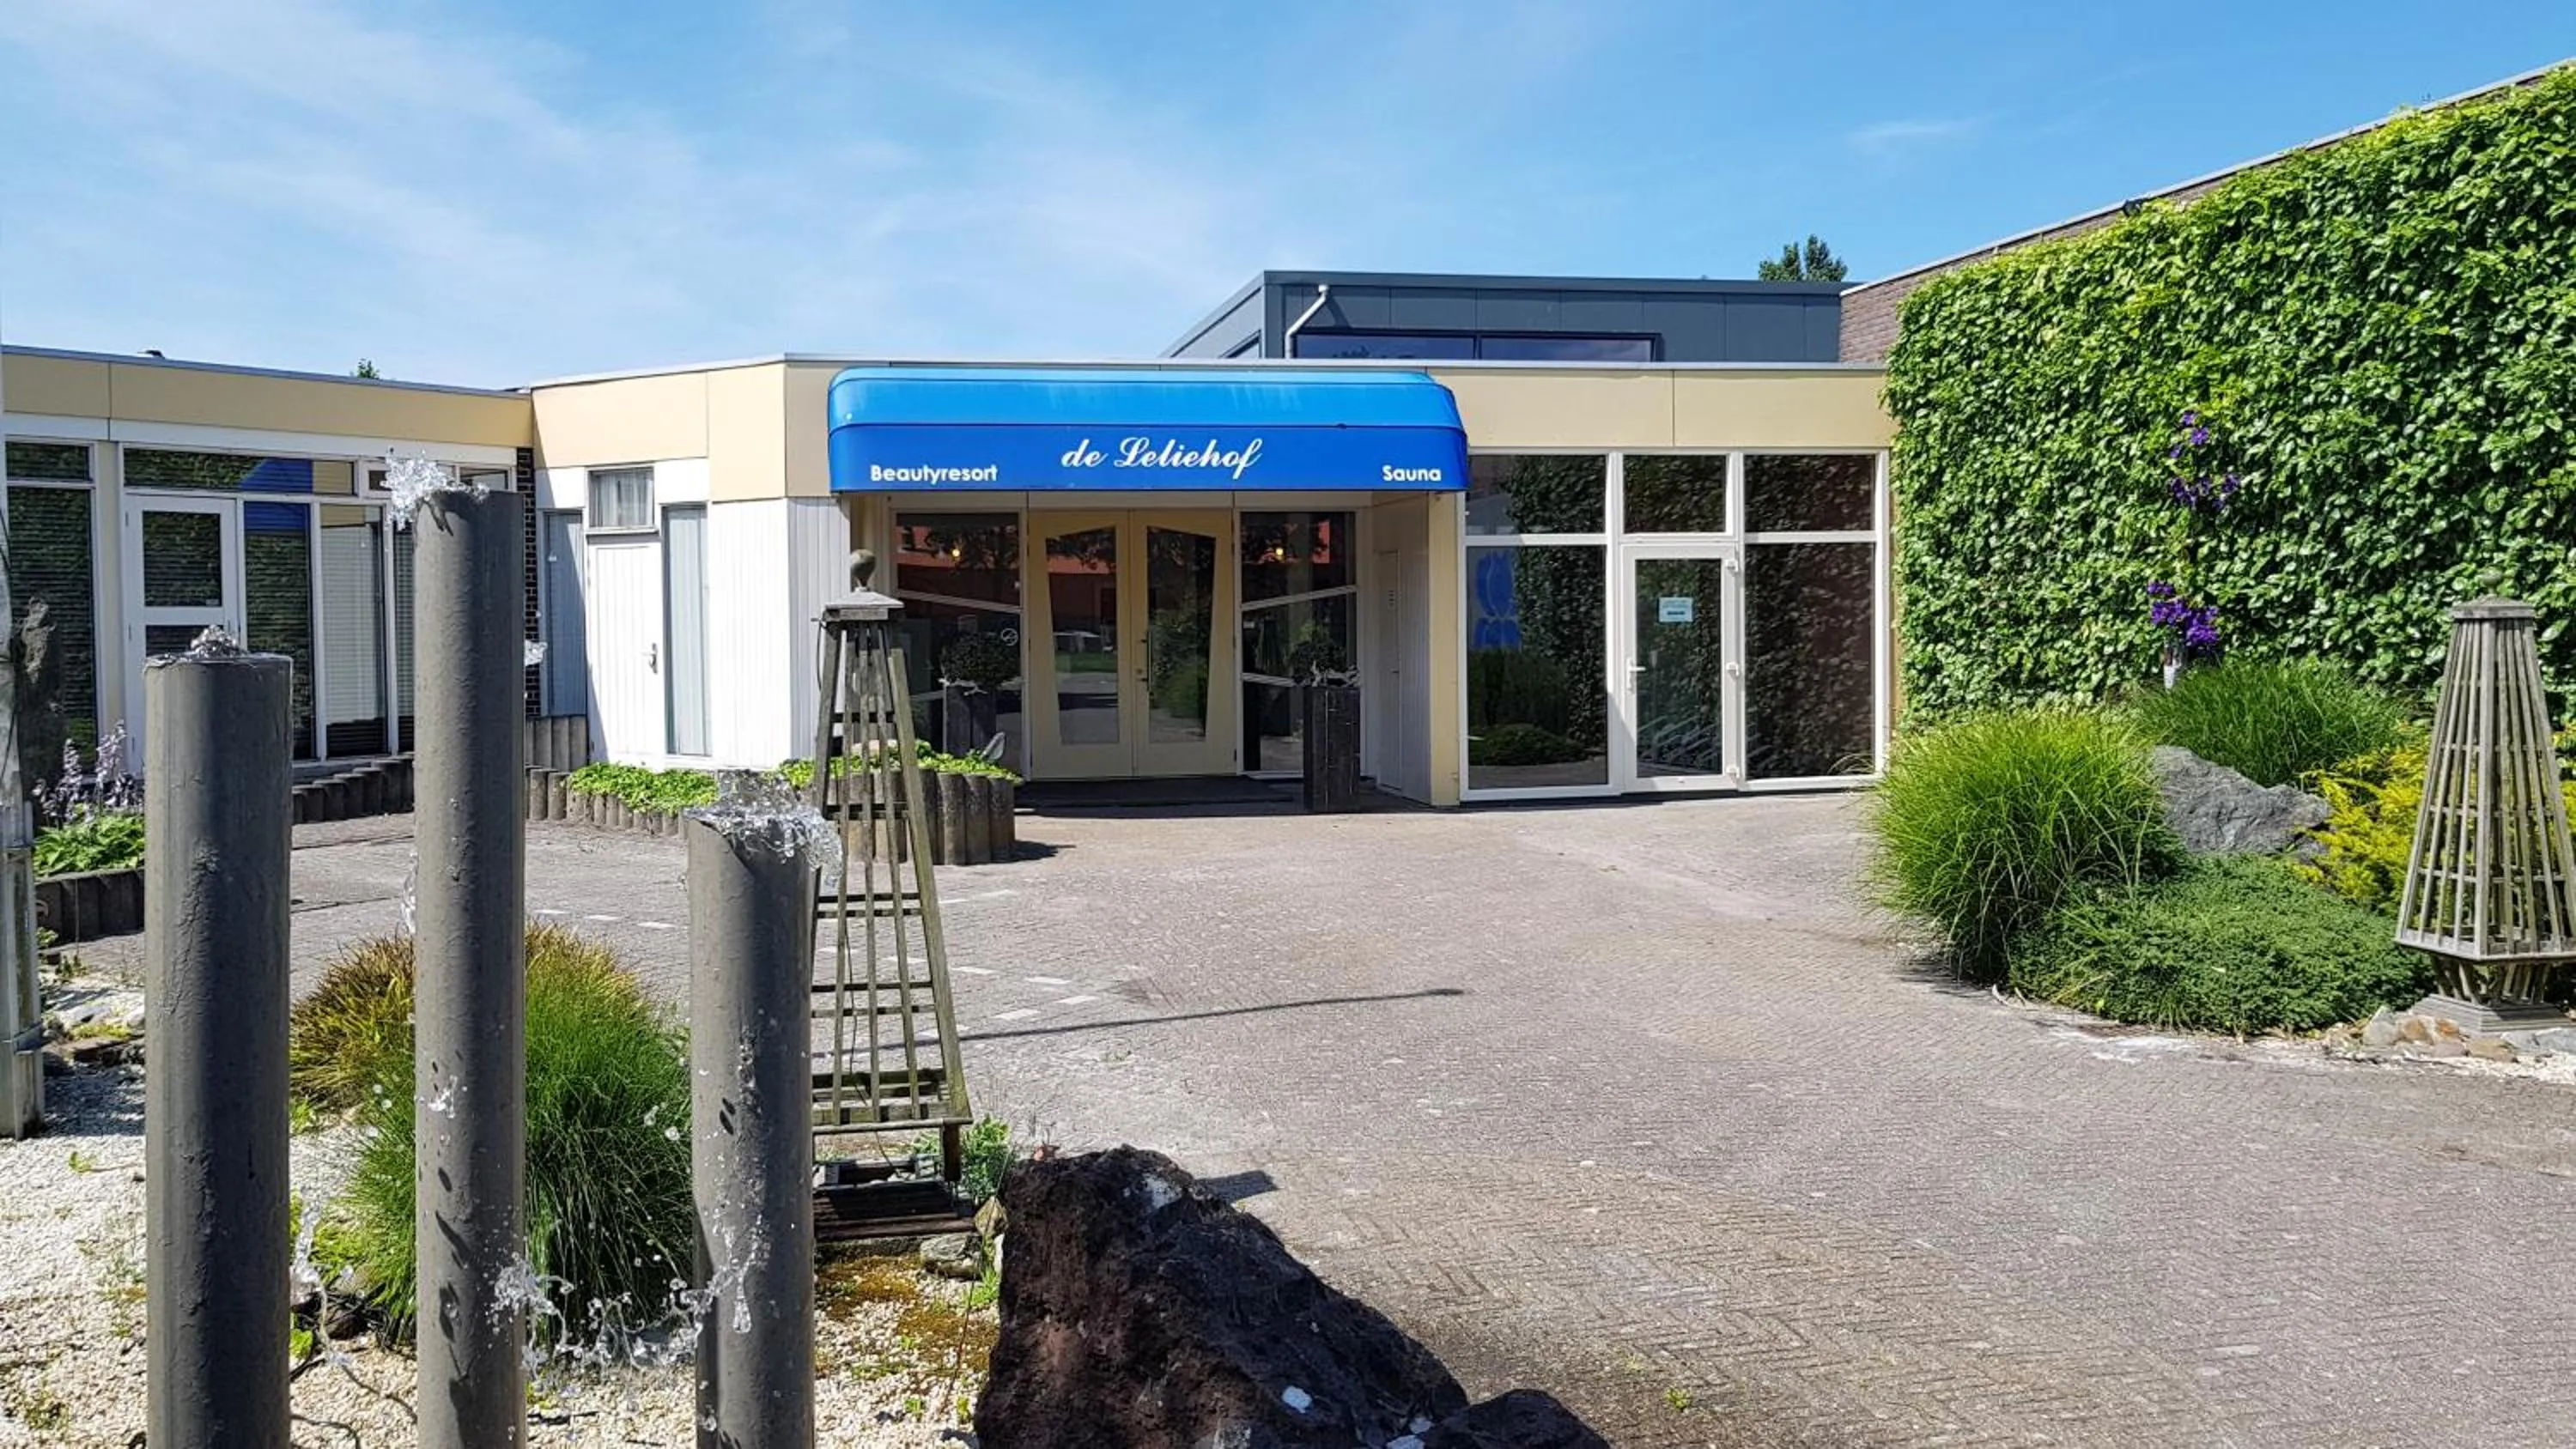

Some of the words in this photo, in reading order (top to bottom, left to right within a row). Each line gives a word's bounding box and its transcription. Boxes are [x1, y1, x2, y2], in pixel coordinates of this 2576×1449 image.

[1061, 439, 1108, 468] de
[1114, 437, 1263, 480] Leliehof
[870, 464, 998, 485] Beautyresort
[1382, 464, 1442, 482] Sauna
